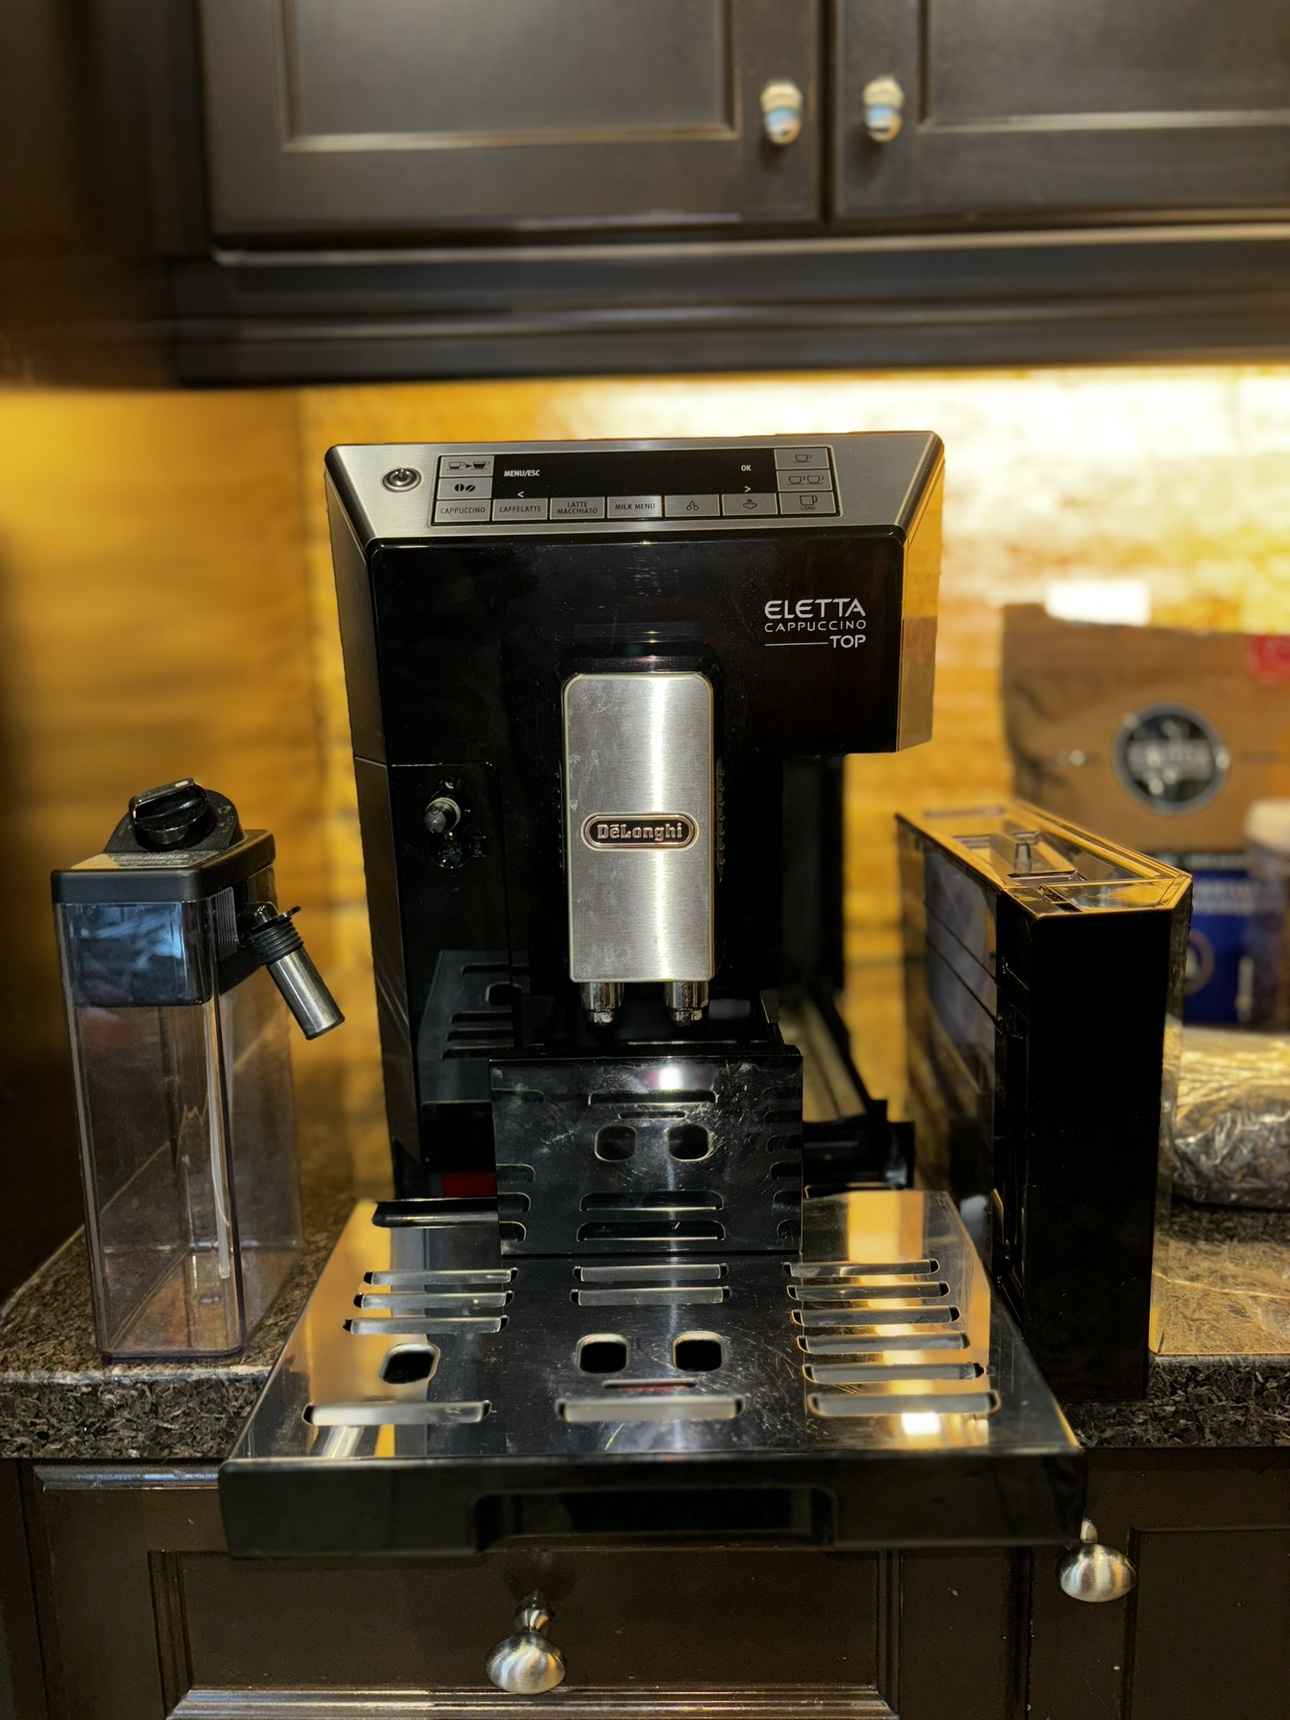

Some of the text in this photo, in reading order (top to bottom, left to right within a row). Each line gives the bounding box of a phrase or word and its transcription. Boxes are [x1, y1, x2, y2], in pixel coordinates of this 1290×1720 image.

[741, 464, 752, 472] OK
[503, 469, 541, 478] MENU/ESC
[440, 507, 486, 515] CAPPUCCINO
[499, 505, 542, 514] CAFFELATTE
[557, 507, 598, 515] MACCHIATO
[614, 503, 656, 511] MILK MENU
[764, 598, 866, 619] ELETTA
[764, 619, 867, 633] CAPPUCCINO
[829, 634, 866, 649] TOP
